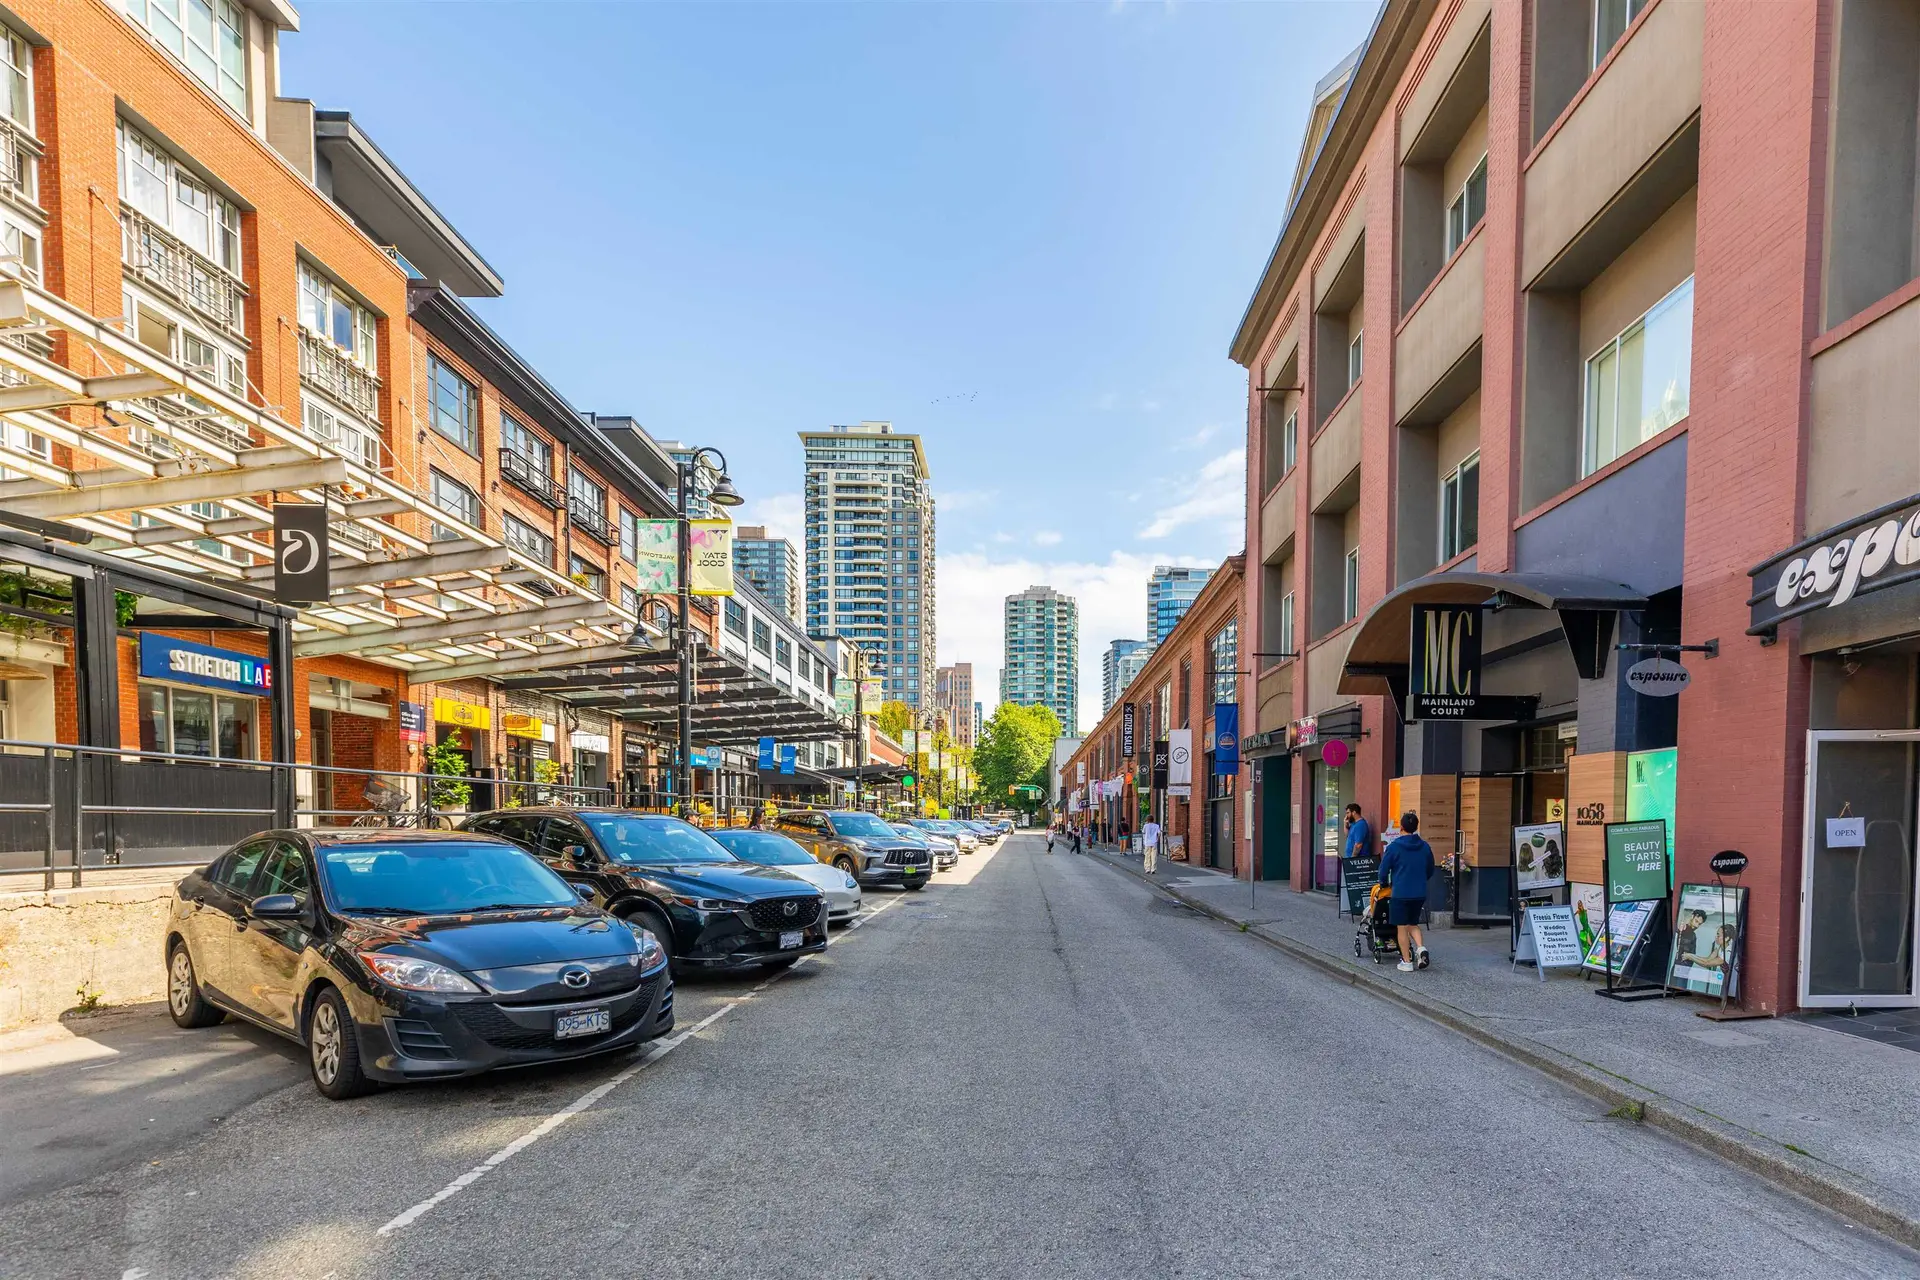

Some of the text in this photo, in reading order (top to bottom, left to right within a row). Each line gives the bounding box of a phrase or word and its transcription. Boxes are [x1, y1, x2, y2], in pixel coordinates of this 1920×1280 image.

[1422, 610, 1473, 696] MC
[1630, 671, 1687, 684] exposure
[1421, 698, 1475, 706] MAINLAND
[1430, 707, 1465, 715] COURT
[1124, 713, 1133, 735] CITIZEN
[1576, 803, 1605, 820] 1058
[1624, 841, 1660, 852] BEAUTY
[1625, 851, 1661, 862] STARTS
[1637, 862, 1662, 872] HERE
[1613, 880, 1633, 896] be
